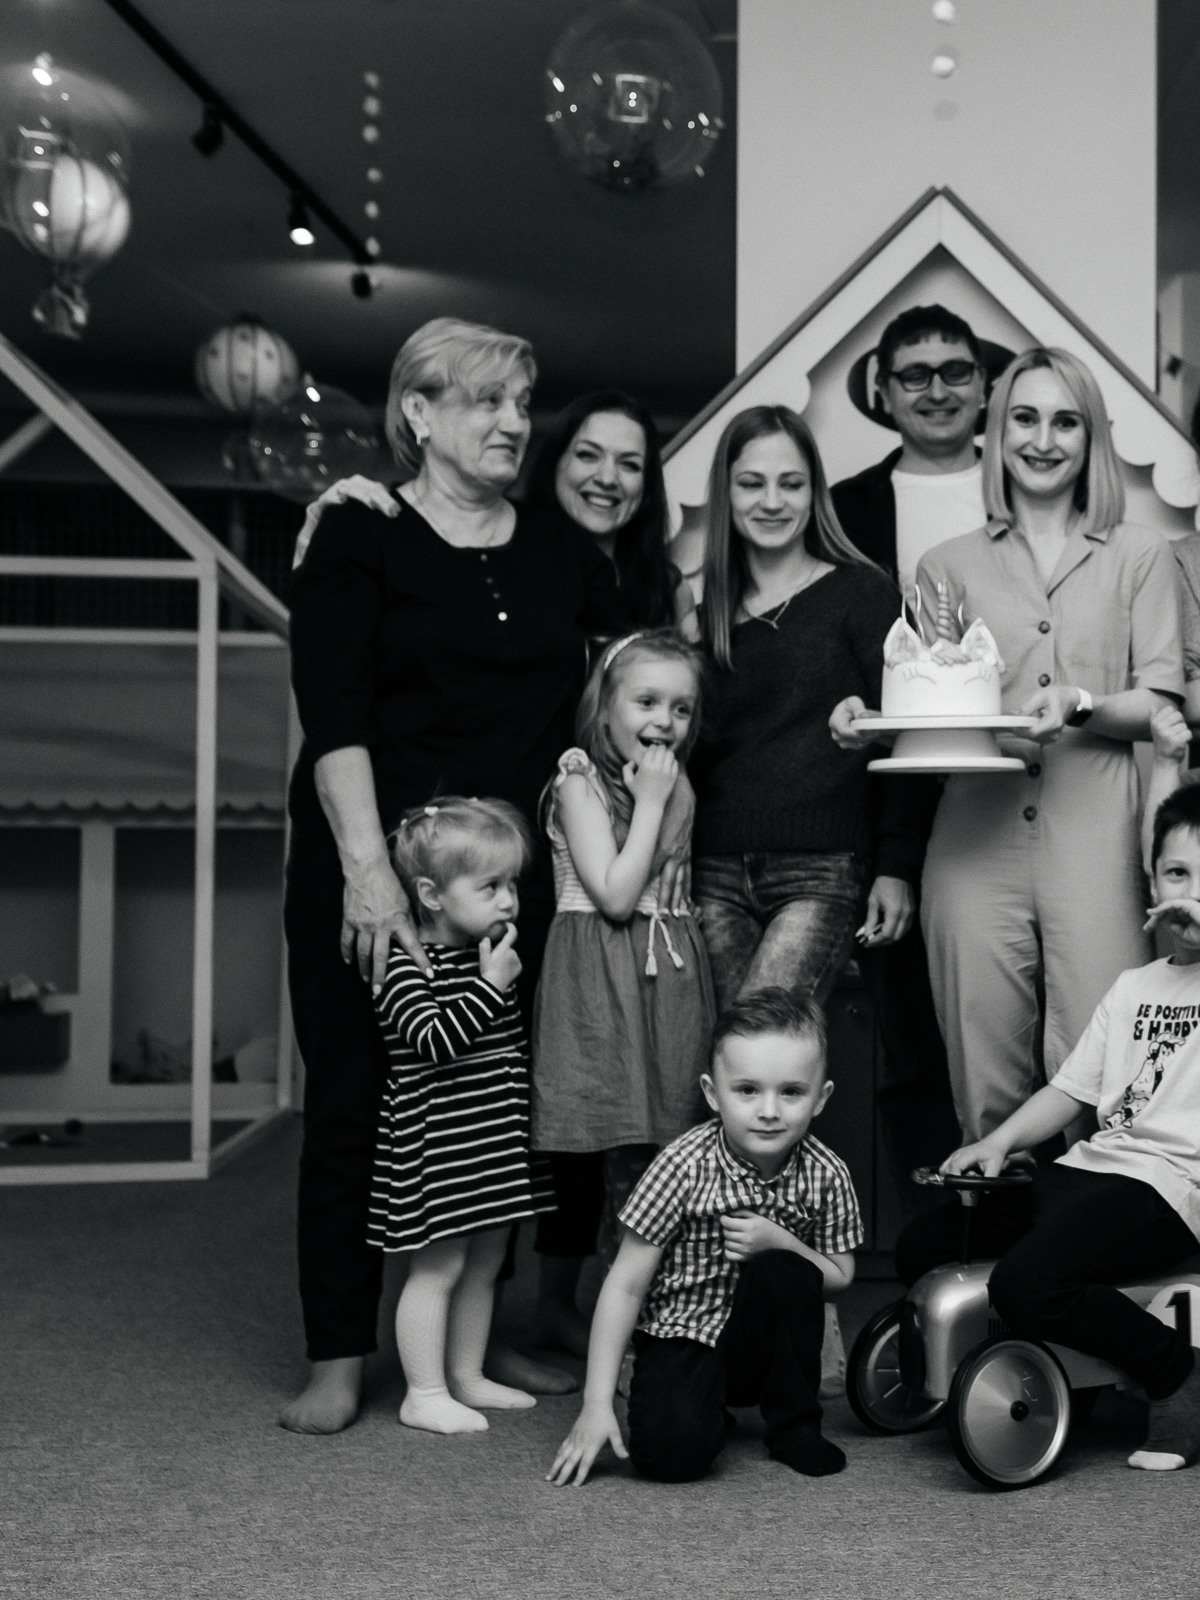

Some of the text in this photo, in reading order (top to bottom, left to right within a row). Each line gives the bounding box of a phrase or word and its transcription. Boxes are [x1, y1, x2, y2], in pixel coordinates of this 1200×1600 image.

[1137, 1003, 1152, 1018] BE
[1133, 1020, 1144, 1041] &
[1165, 1290, 1191, 1346] 1
